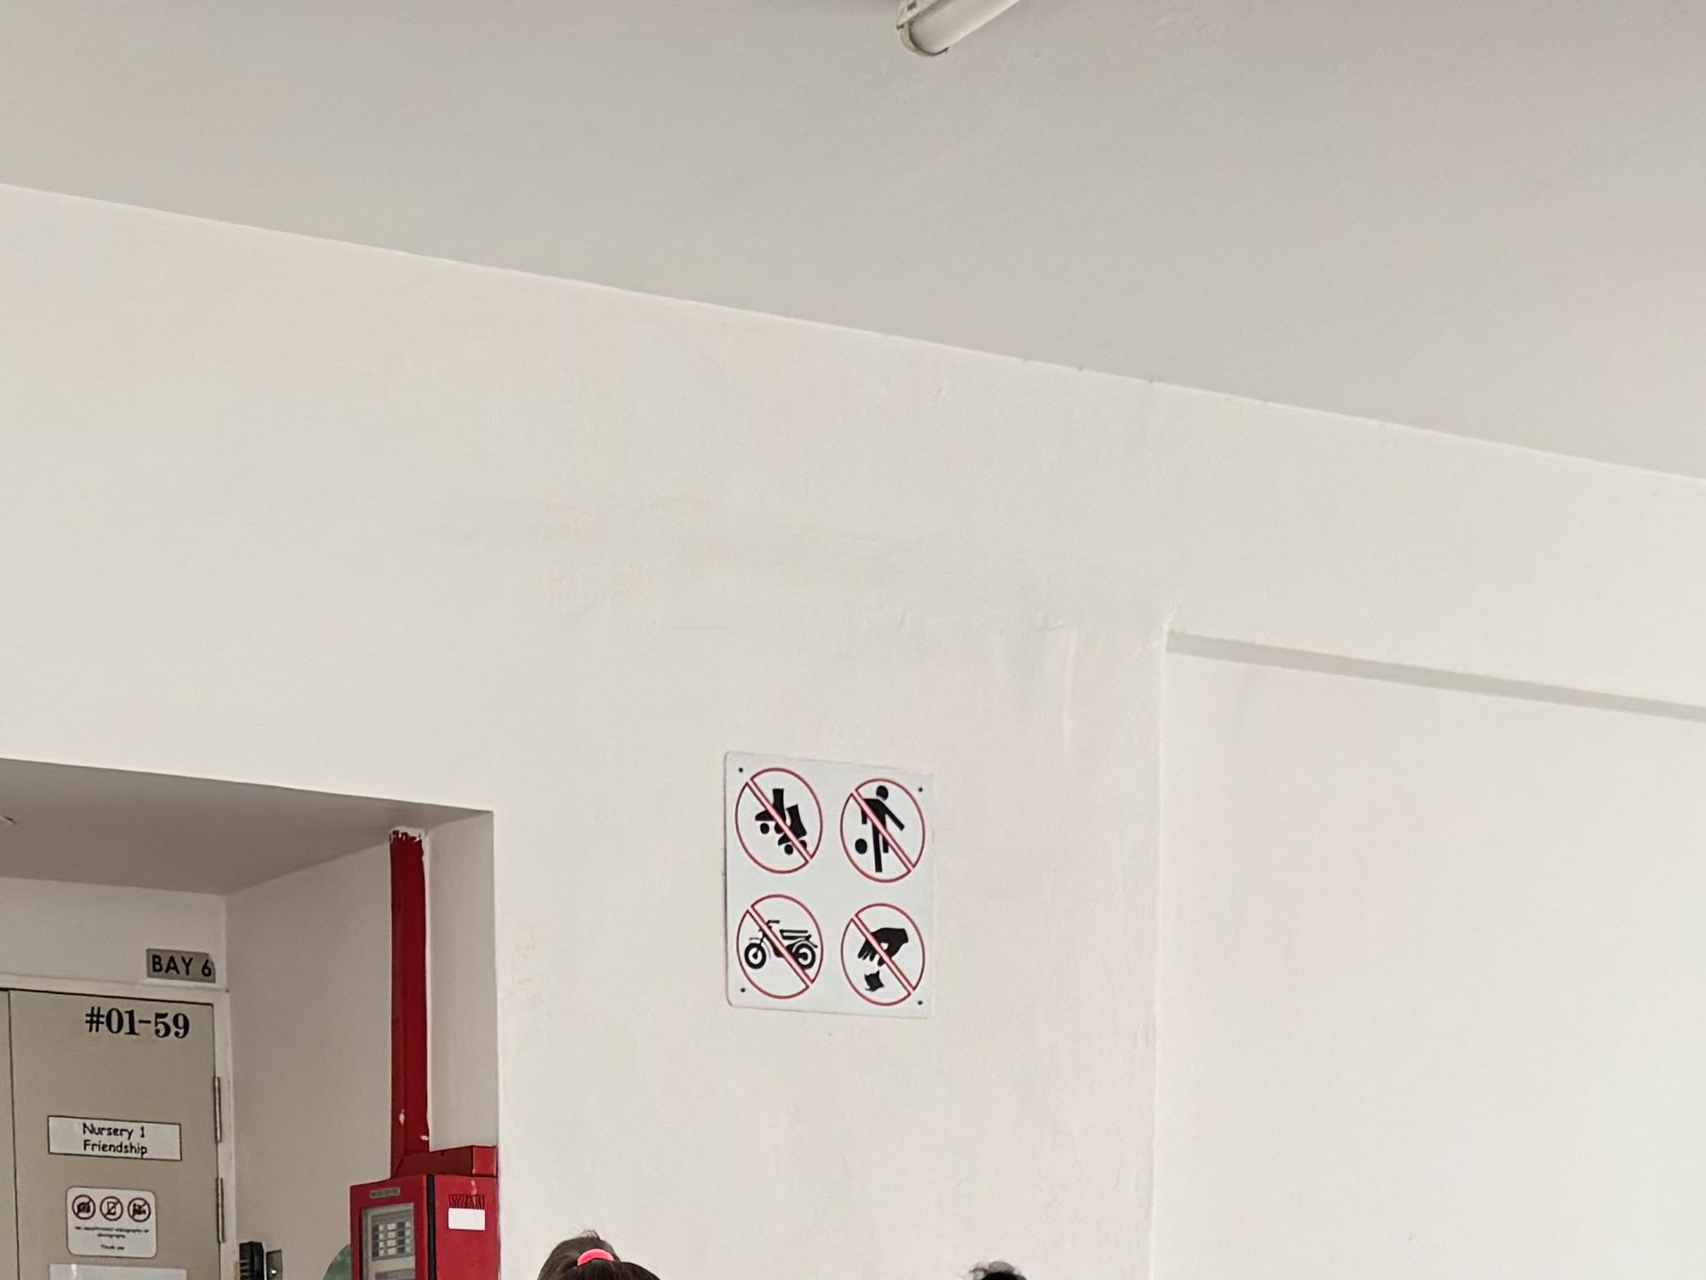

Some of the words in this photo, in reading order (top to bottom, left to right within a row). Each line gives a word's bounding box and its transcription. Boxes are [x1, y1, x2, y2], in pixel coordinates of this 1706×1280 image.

[151, 953, 194, 976] BAY
[200, 958, 212, 978] 6
[84, 1005, 190, 1039] #01-59
[82, 1122, 134, 1141] Nursery
[139, 1126, 146, 1138] 1
[83, 1140, 149, 1160] Friendship
